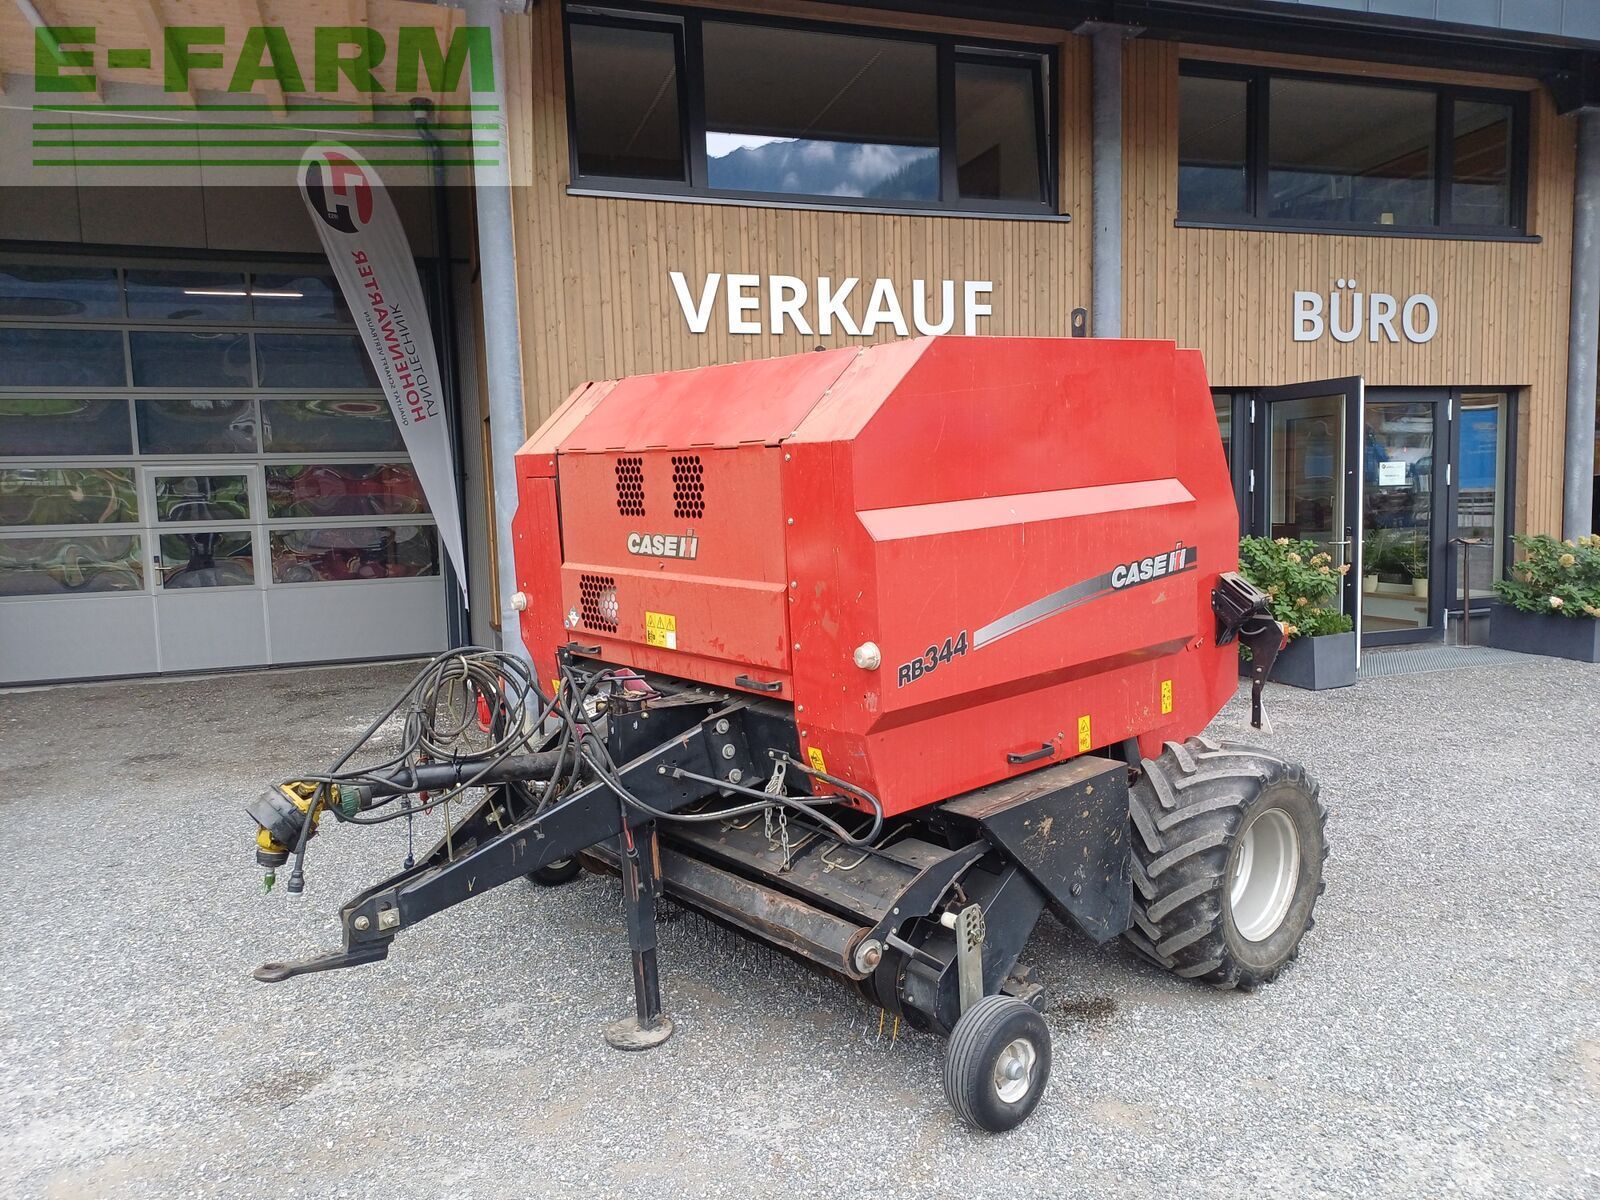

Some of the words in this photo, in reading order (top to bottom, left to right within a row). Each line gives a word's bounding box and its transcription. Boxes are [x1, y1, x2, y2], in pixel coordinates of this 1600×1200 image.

[669, 271, 993, 336] VERKAUF
[1293, 278, 1439, 344] BÜRO
[627, 532, 679, 557] CASE
[1111, 553, 1168, 588] CASE
[898, 629, 968, 688] RB344
